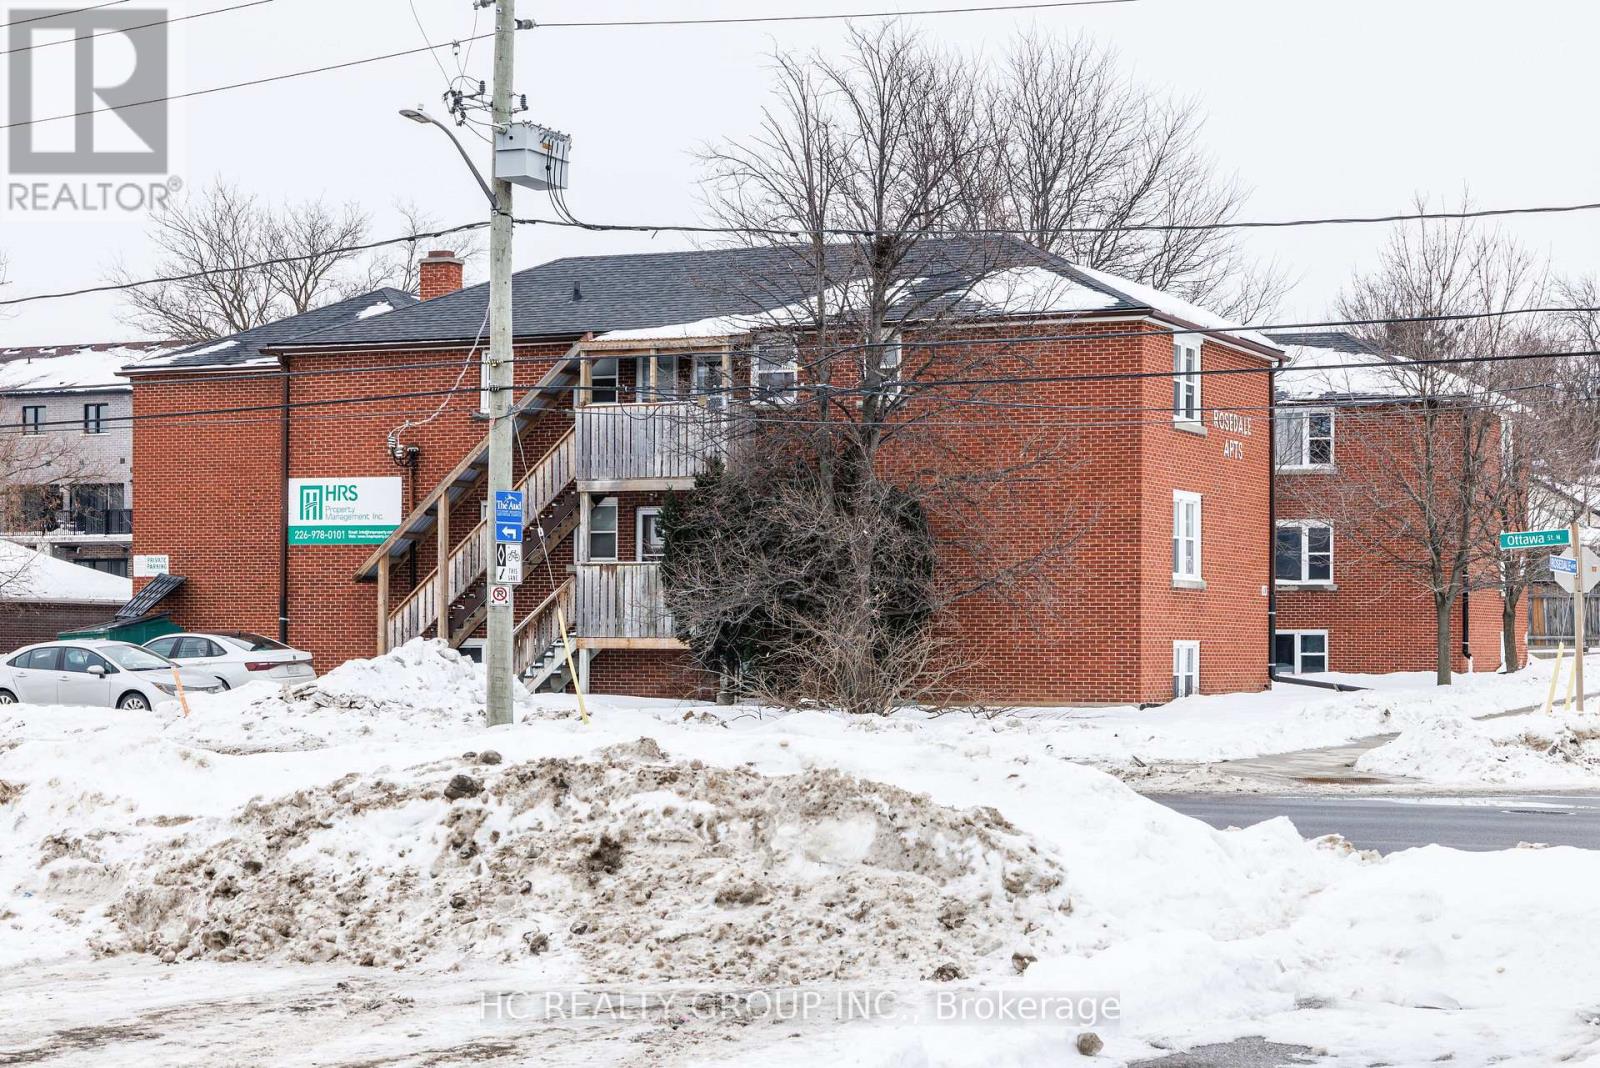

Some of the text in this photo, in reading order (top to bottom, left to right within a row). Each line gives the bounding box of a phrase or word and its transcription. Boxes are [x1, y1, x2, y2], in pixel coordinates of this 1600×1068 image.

[1213, 409, 1251, 435] ROSEDALE
[1223, 439, 1243, 460] APTS
[325, 485, 358, 501] HRS
[325, 506, 355, 515] Property
[497, 500, 522, 510] The Aud
[325, 513, 369, 522] Management
[294, 530, 345, 540] 226-978-0101
[1507, 534, 1545, 546] Ottawa
